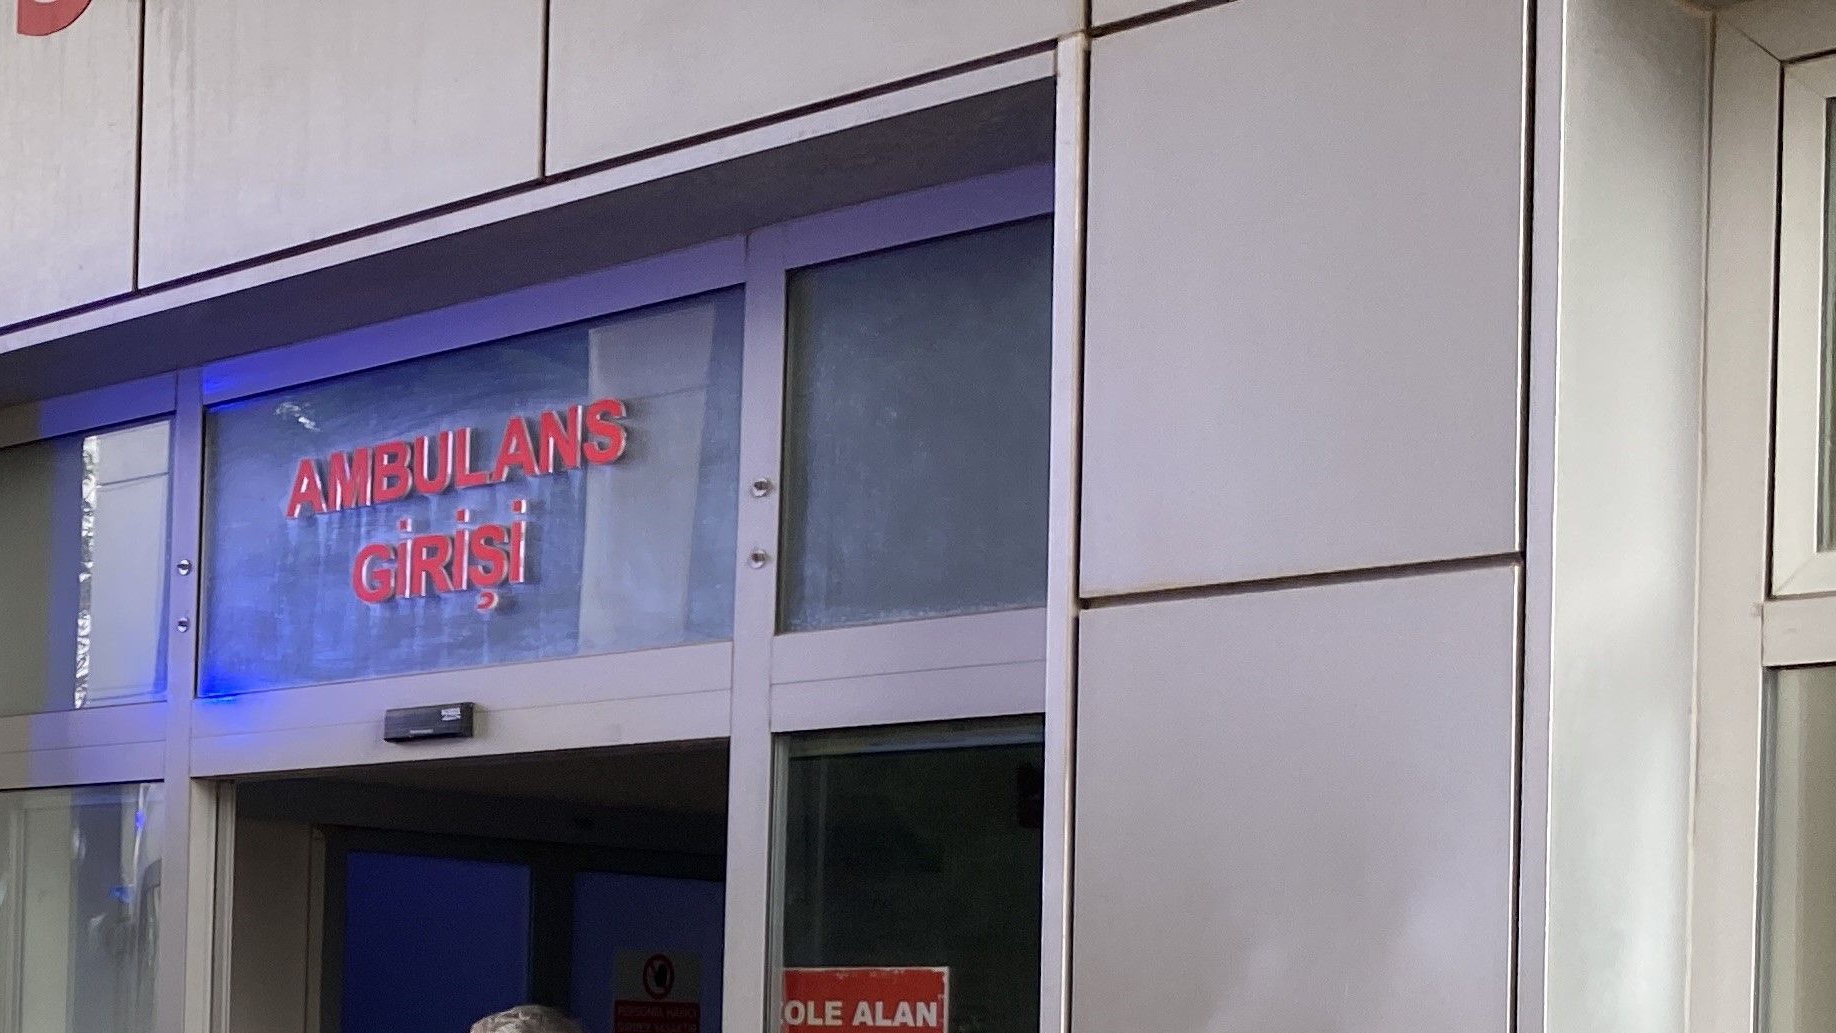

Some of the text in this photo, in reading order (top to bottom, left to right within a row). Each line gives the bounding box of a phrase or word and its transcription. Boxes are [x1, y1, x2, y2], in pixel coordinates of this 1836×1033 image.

[285, 399, 627, 519] AMBULANS
[351, 499, 527, 613] GİRİŞİ
[781, 1001, 938, 1027] OLE ALAN
